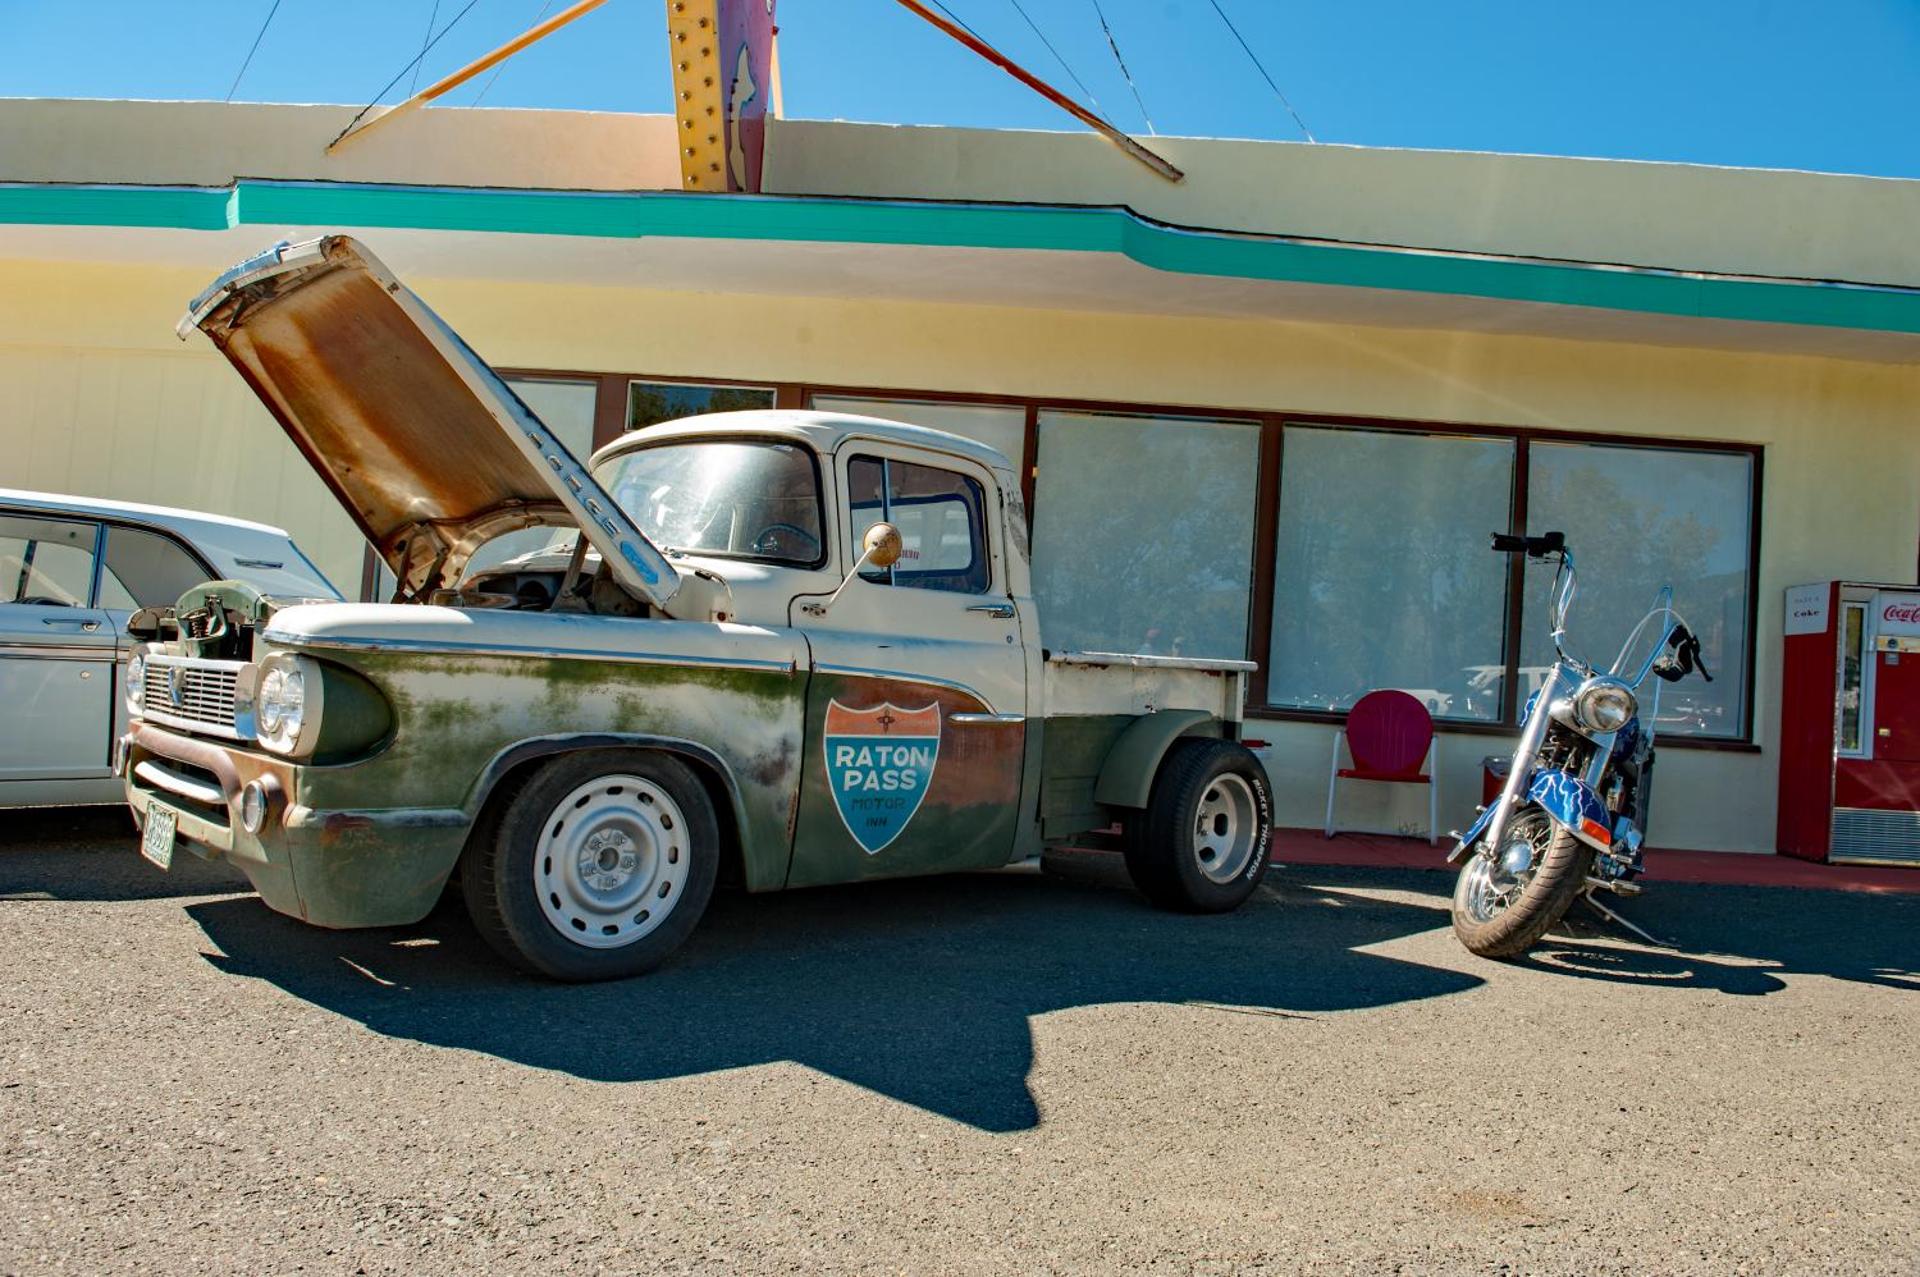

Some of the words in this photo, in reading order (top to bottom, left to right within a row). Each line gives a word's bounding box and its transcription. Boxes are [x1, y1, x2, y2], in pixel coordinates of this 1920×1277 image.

[835, 745, 929, 768] RATON
[843, 769, 917, 791] PASS
[851, 797, 906, 811] MOTOR
[866, 816, 888, 827] INN
[1246, 823, 1270, 881] THOMPSON
